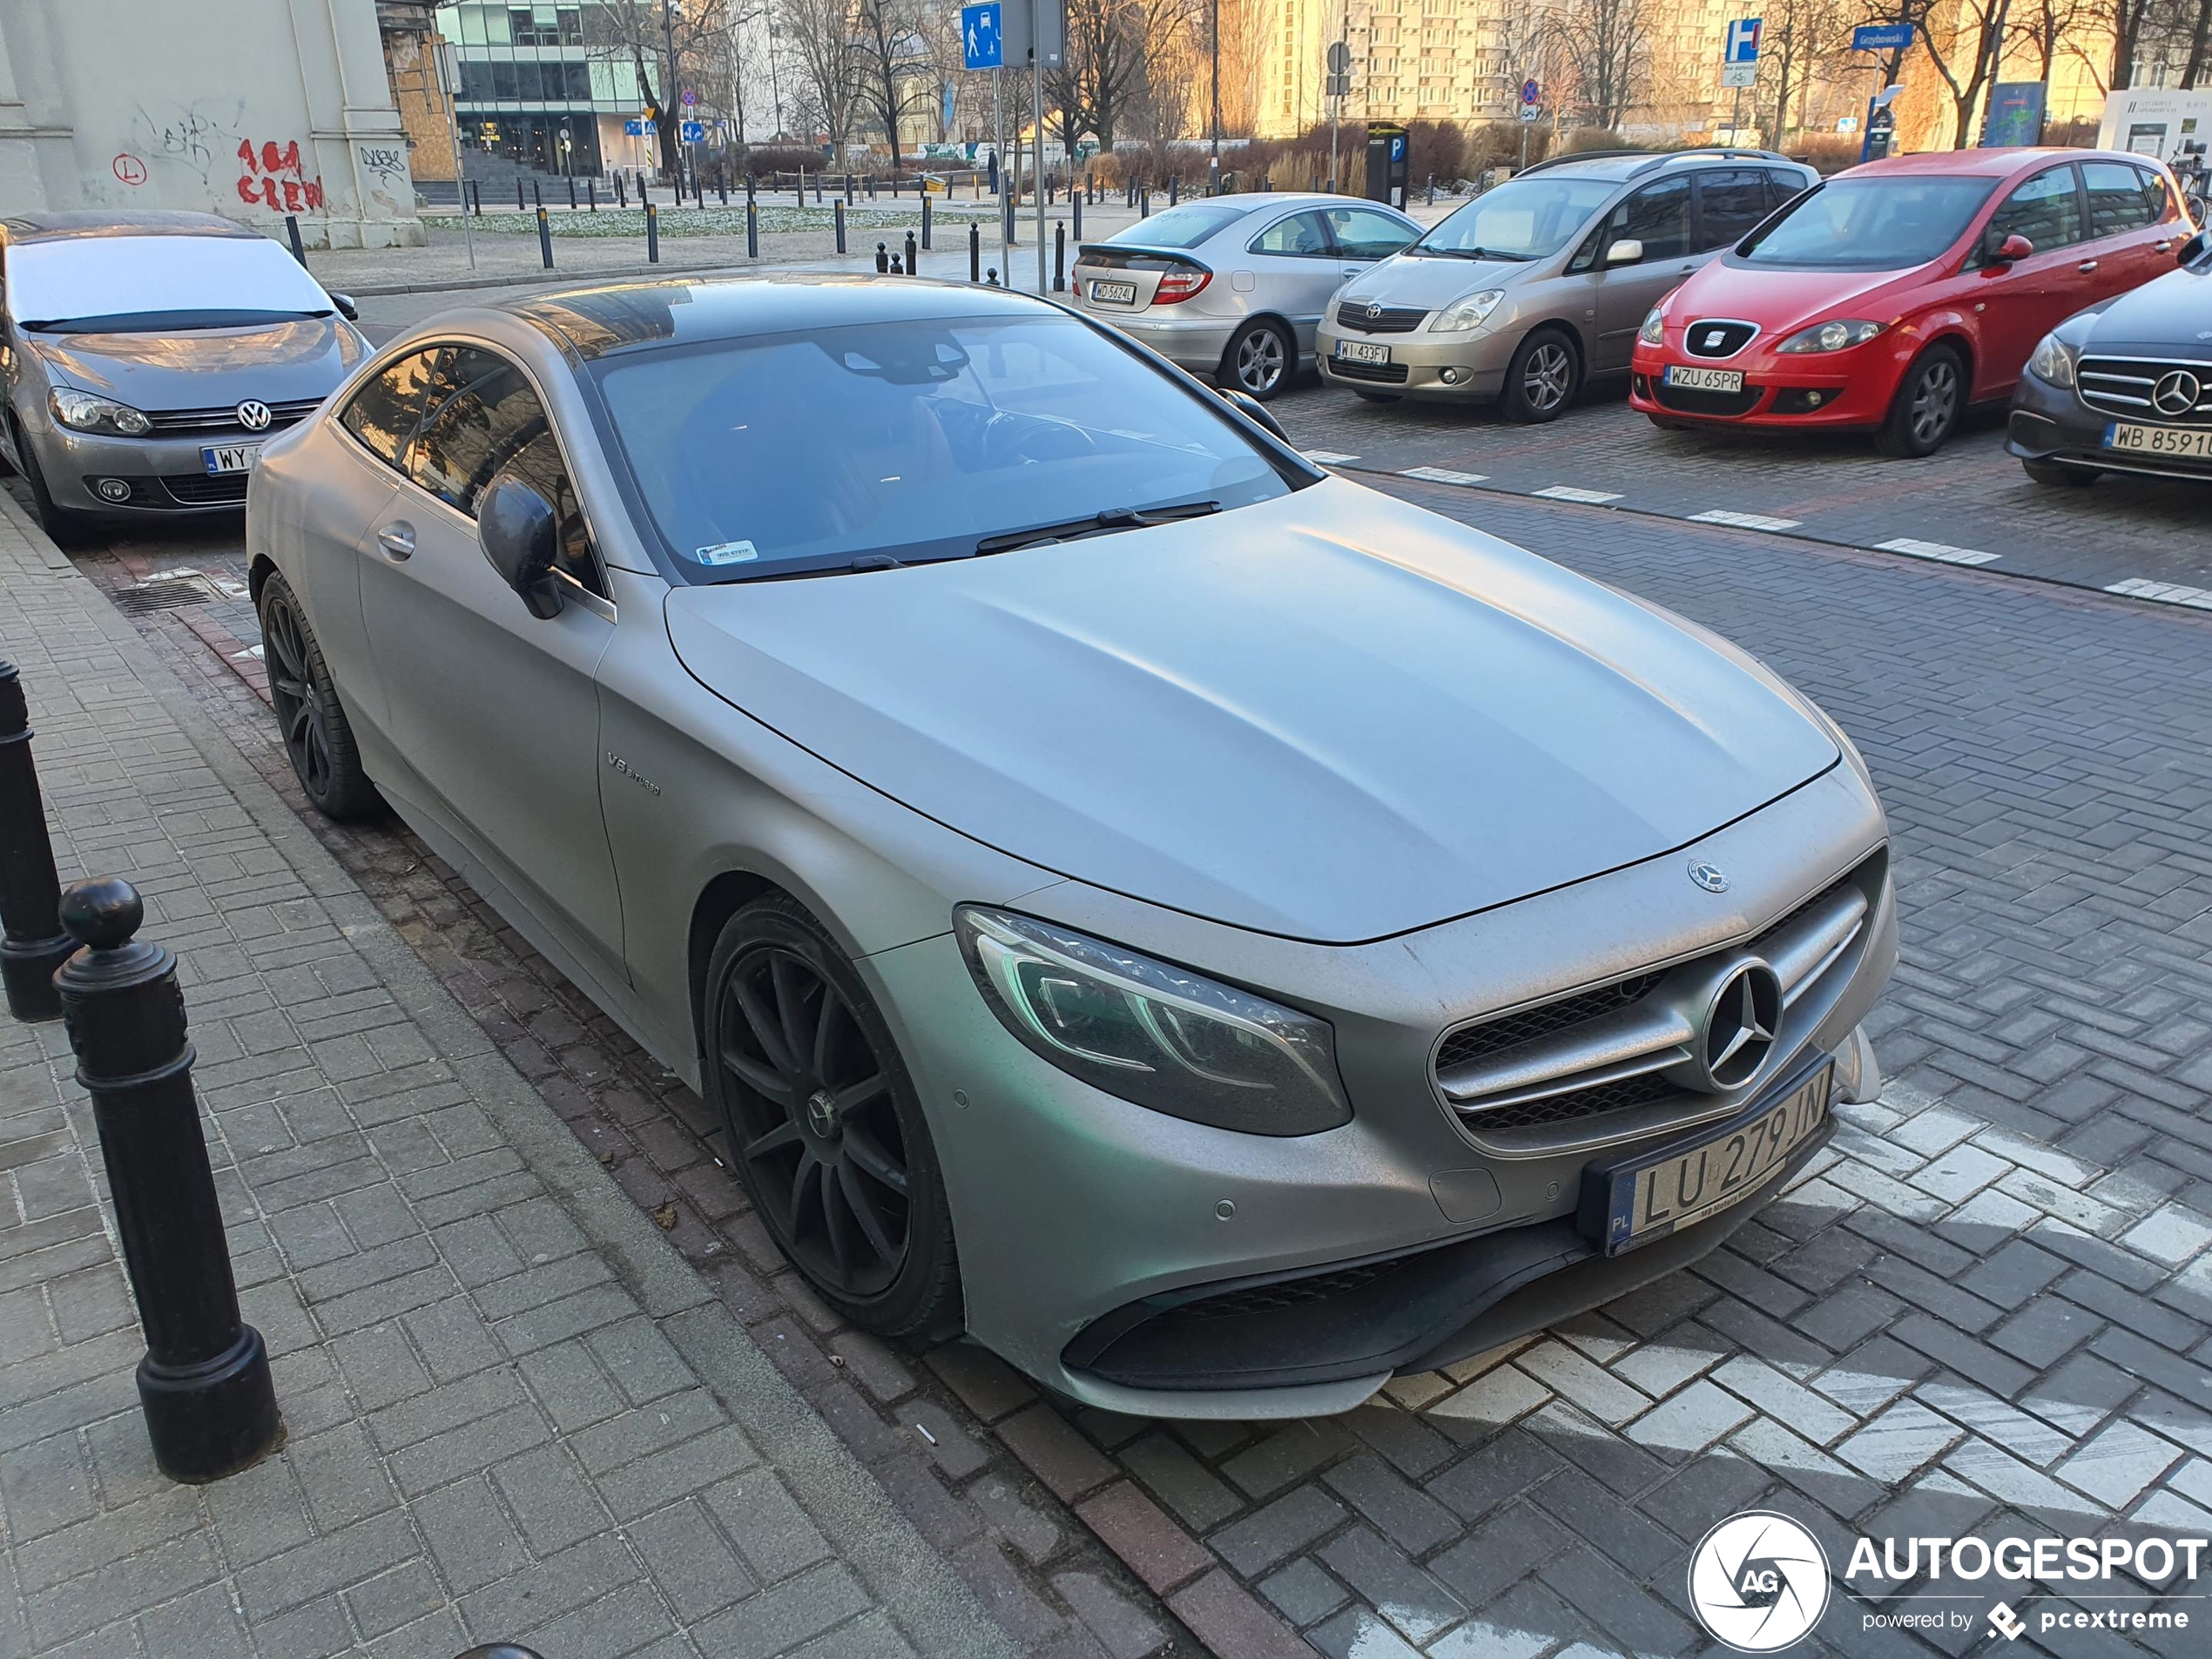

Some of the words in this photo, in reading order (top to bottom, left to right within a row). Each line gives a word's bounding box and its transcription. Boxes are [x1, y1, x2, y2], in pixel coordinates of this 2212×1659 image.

[1859, 33, 1905, 47] Grzybowski
[1393, 138, 1401, 157] P
[1097, 284, 1107, 297] WD
[1109, 285, 1131, 300] 5624L
[1342, 342, 1353, 357] WI
[1359, 345, 1387, 361] 433FV
[1672, 368, 1701, 386] WZU
[1704, 371, 1740, 390] 65PR
[2117, 425, 2144, 448] WB
[219, 448, 245, 469] WY
[607, 752, 627, 774] V8
[626, 768, 661, 796] BITURBO
[1644, 1149, 1708, 1226] LU
[1719, 1073, 1825, 1193] 279JN
[1612, 1215, 1629, 1232] PL
